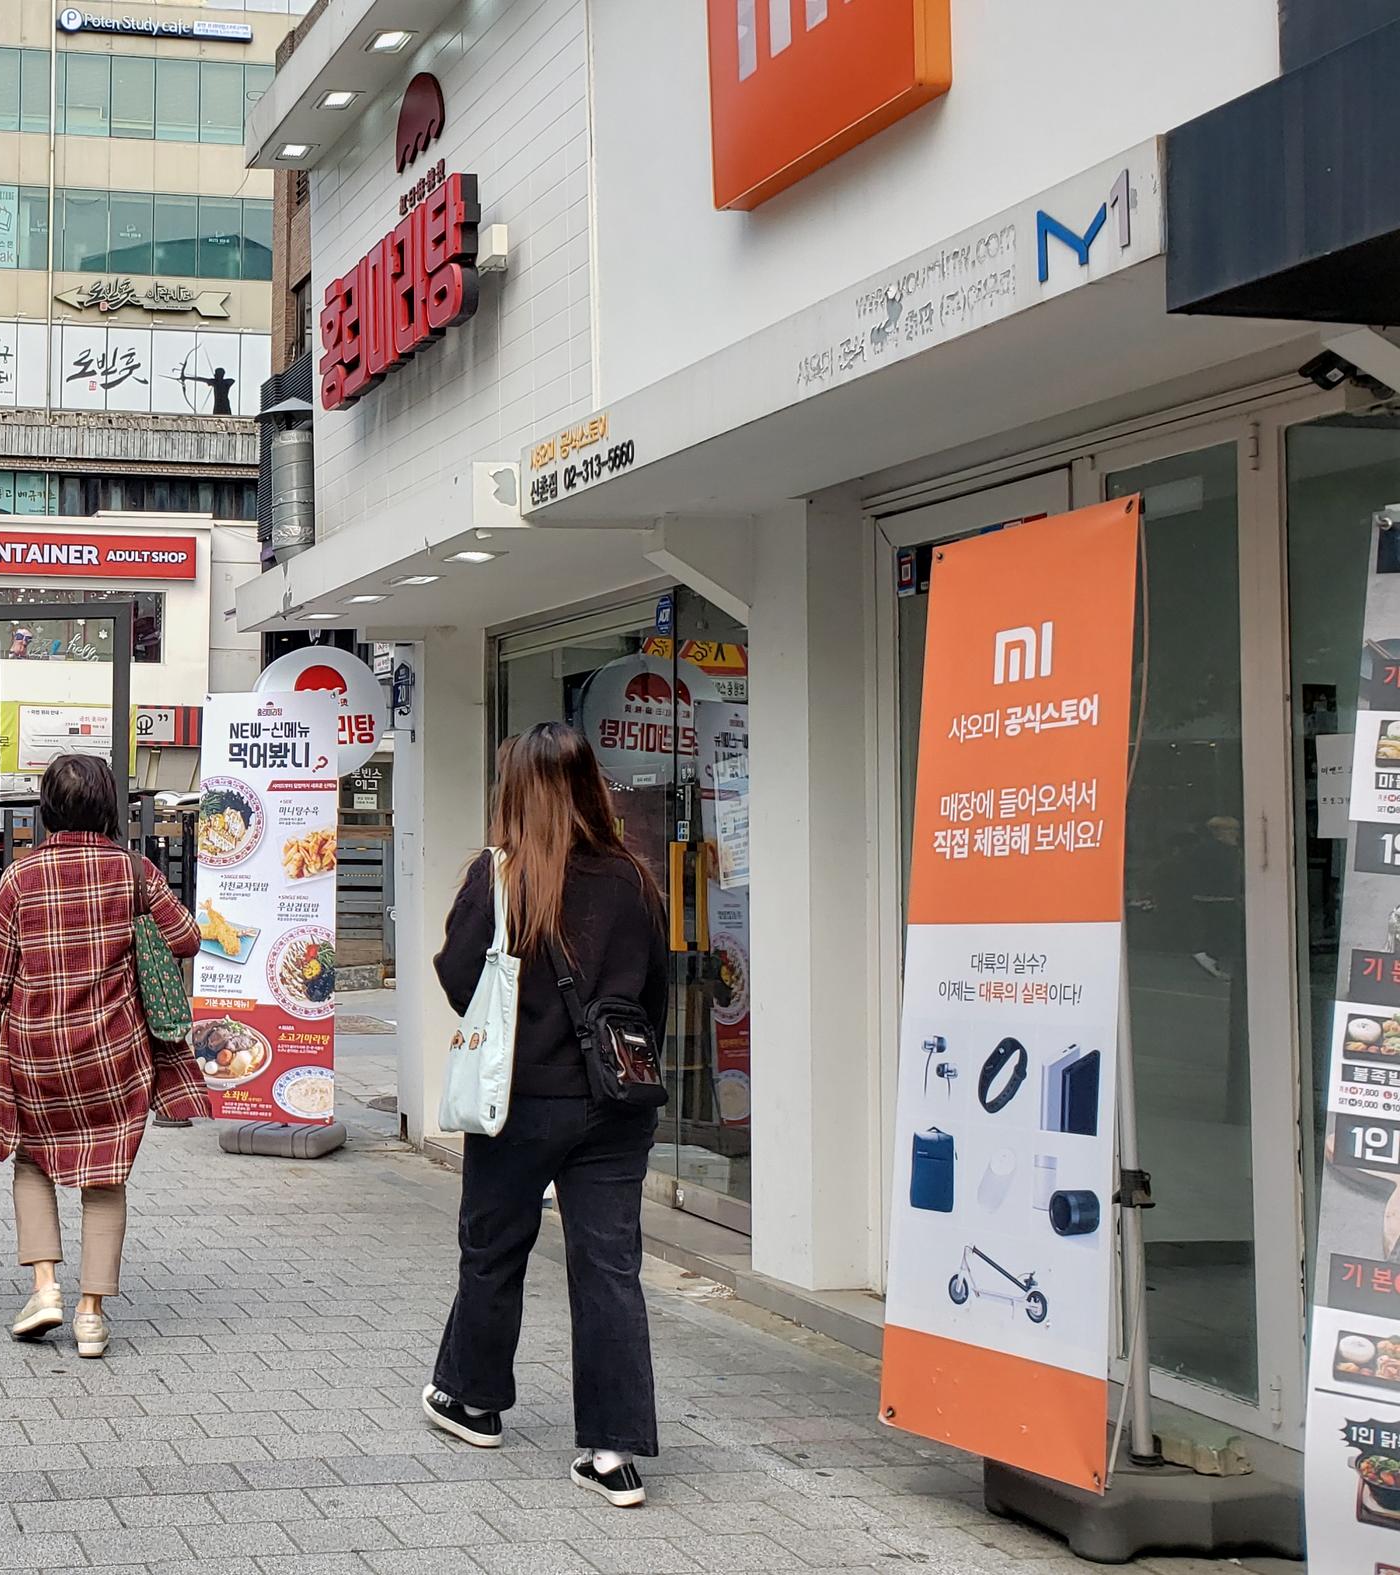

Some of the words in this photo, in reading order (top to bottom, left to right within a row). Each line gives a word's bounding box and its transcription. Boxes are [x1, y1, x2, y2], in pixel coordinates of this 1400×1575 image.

[84, 13, 120, 30] Poten
[122, 15, 159, 36] Study
[162, 20, 191, 36] cafe
[530, 436, 556, 471] 샤오미
[560, 413, 609, 459] 공식스토어
[531, 470, 558, 506] 신촌점
[563, 439, 635, 491] 02-313-5660
[106, 550, 150, 563] ADULT
[151, 551, 188, 564] SHOP
[658, 608, 671, 624] ADT
[948, 709, 1001, 743] 샤오미
[1004, 694, 1100, 737] 공식스토어
[229, 722, 310, 739] NEW-신메뉴
[354, 779, 378, 791] 에그
[940, 789, 995, 822] 매장에
[998, 778, 1097, 819] 들어오셔서
[278, 806, 319, 816] 미니탕수육
[933, 828, 969, 860] 직접
[974, 823, 1031, 858] 체험해
[1034, 819, 1104, 852] 보세요!
[970, 952, 1010, 974] 대륙의
[1012, 953, 1048, 975] 실수?
[200, 973, 242, 984] 왕새우튀김
[938, 980, 976, 1002] 이제는
[979, 981, 1018, 1003] 대륙의
[1021, 982, 1083, 1006] 실력이다!
[205, 999, 218, 1007] 기본
[219, 999, 233, 1008] 추천
[277, 1033, 330, 1045] 소고기마라탕
[1358, 1088, 1379, 1098] 7,800
[1357, 1100, 1379, 1110] 9,000
[1351, 1426, 1374, 1445] 1인
